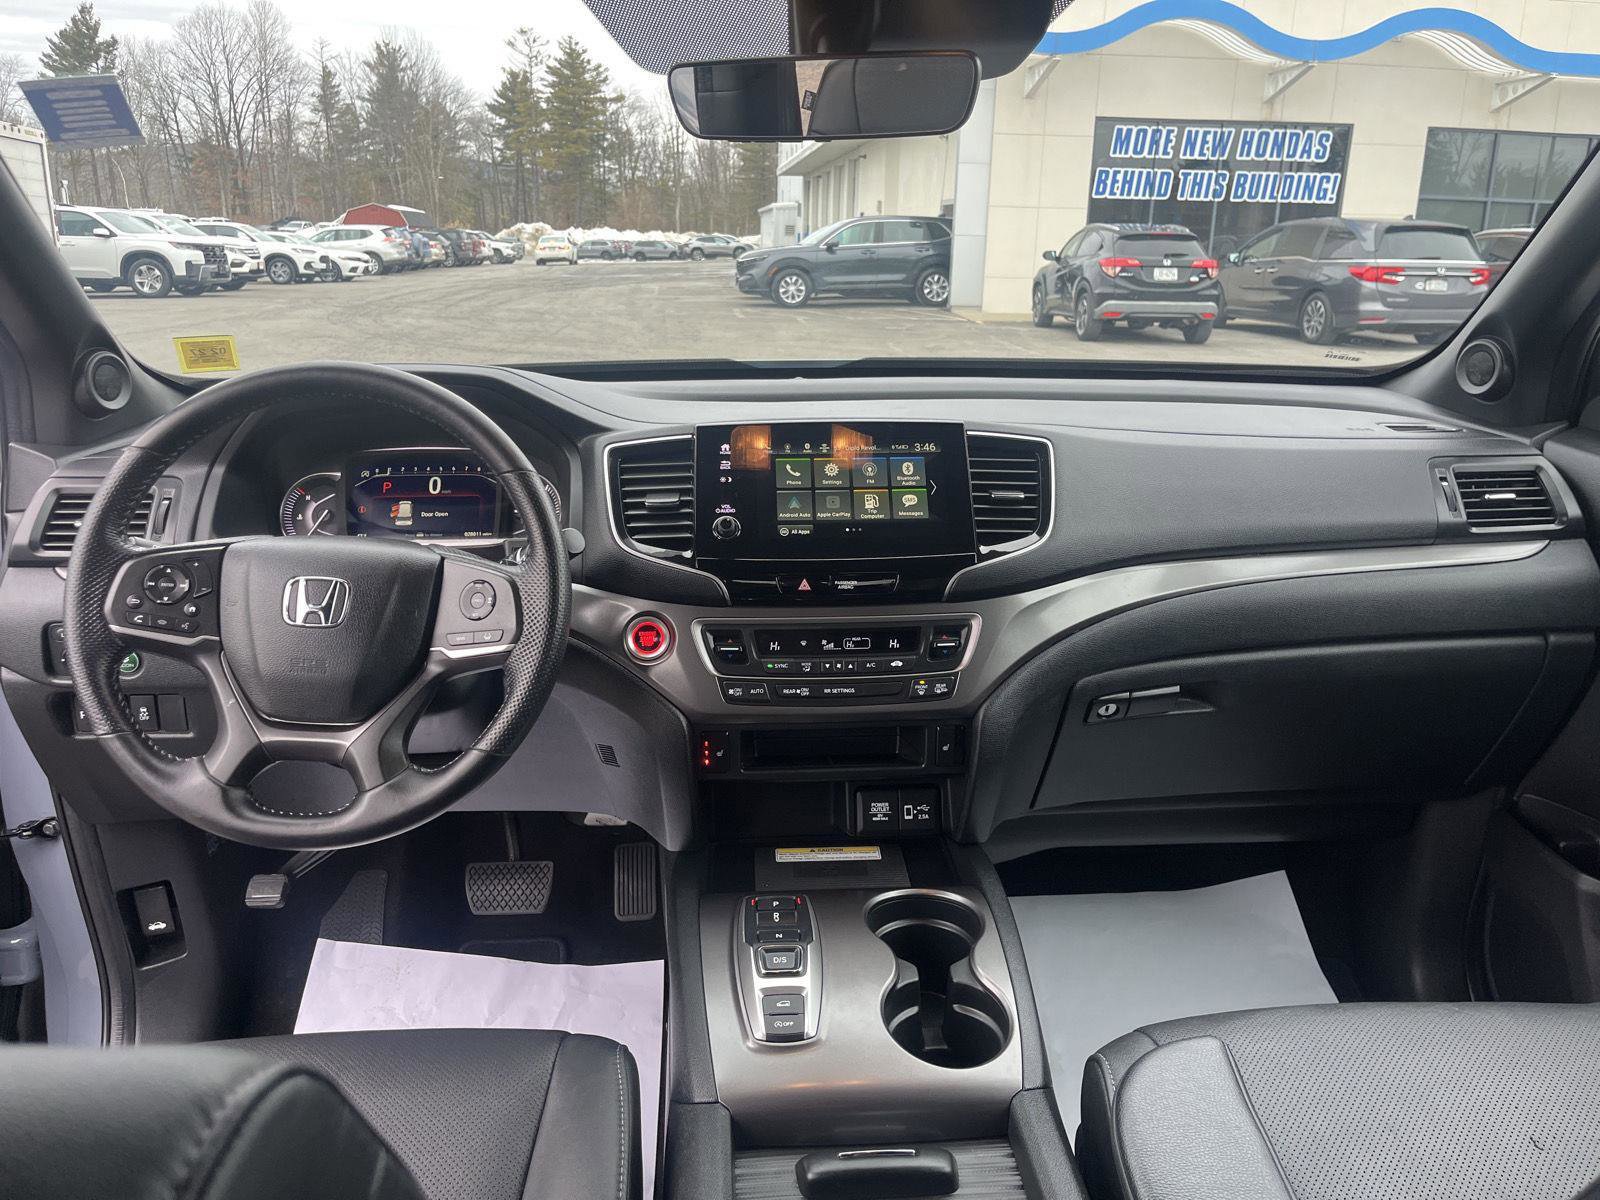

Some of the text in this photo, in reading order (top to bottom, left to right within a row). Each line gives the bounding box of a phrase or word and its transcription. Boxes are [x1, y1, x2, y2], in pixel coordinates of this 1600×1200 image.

[1110, 125, 1332, 162] MORE NEW HONDAS
[1092, 167, 1341, 204] BEHIND THIS BUILDING!
[914, 443, 936, 452] 3:46
[383, 481, 392, 494] P
[428, 476, 442, 495] 0
[773, 956, 787, 964] D/S
